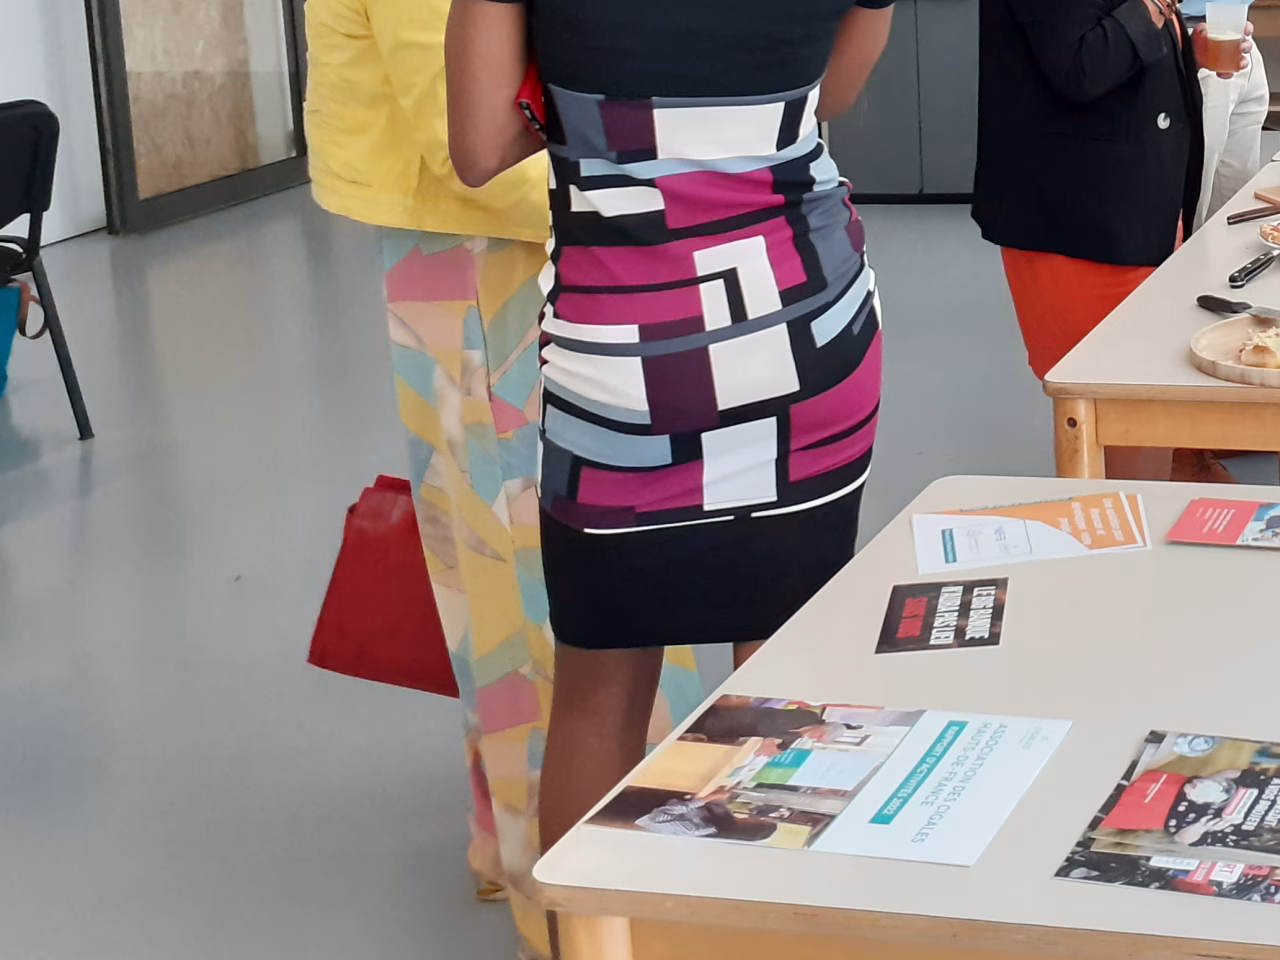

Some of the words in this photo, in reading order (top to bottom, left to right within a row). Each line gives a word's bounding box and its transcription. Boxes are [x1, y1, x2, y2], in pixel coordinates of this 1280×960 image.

[973, 586, 996, 596] LE
[933, 611, 959, 627] PAS
[965, 608, 993, 640] BANQUE
[928, 726, 961, 755] RAPPORT
[955, 724, 1012, 783] ASSOCIATION
[895, 756, 938, 797] D'ACTIVITÉS
[919, 723, 992, 826] HAUTS-DE-FRANCE
[881, 797, 903, 814] 2022
[941, 785, 966, 802] DES
[1260, 784, 1280, 800] VOS
[910, 804, 951, 843] CIGALES
[1240, 799, 1272, 831] PROJETS
